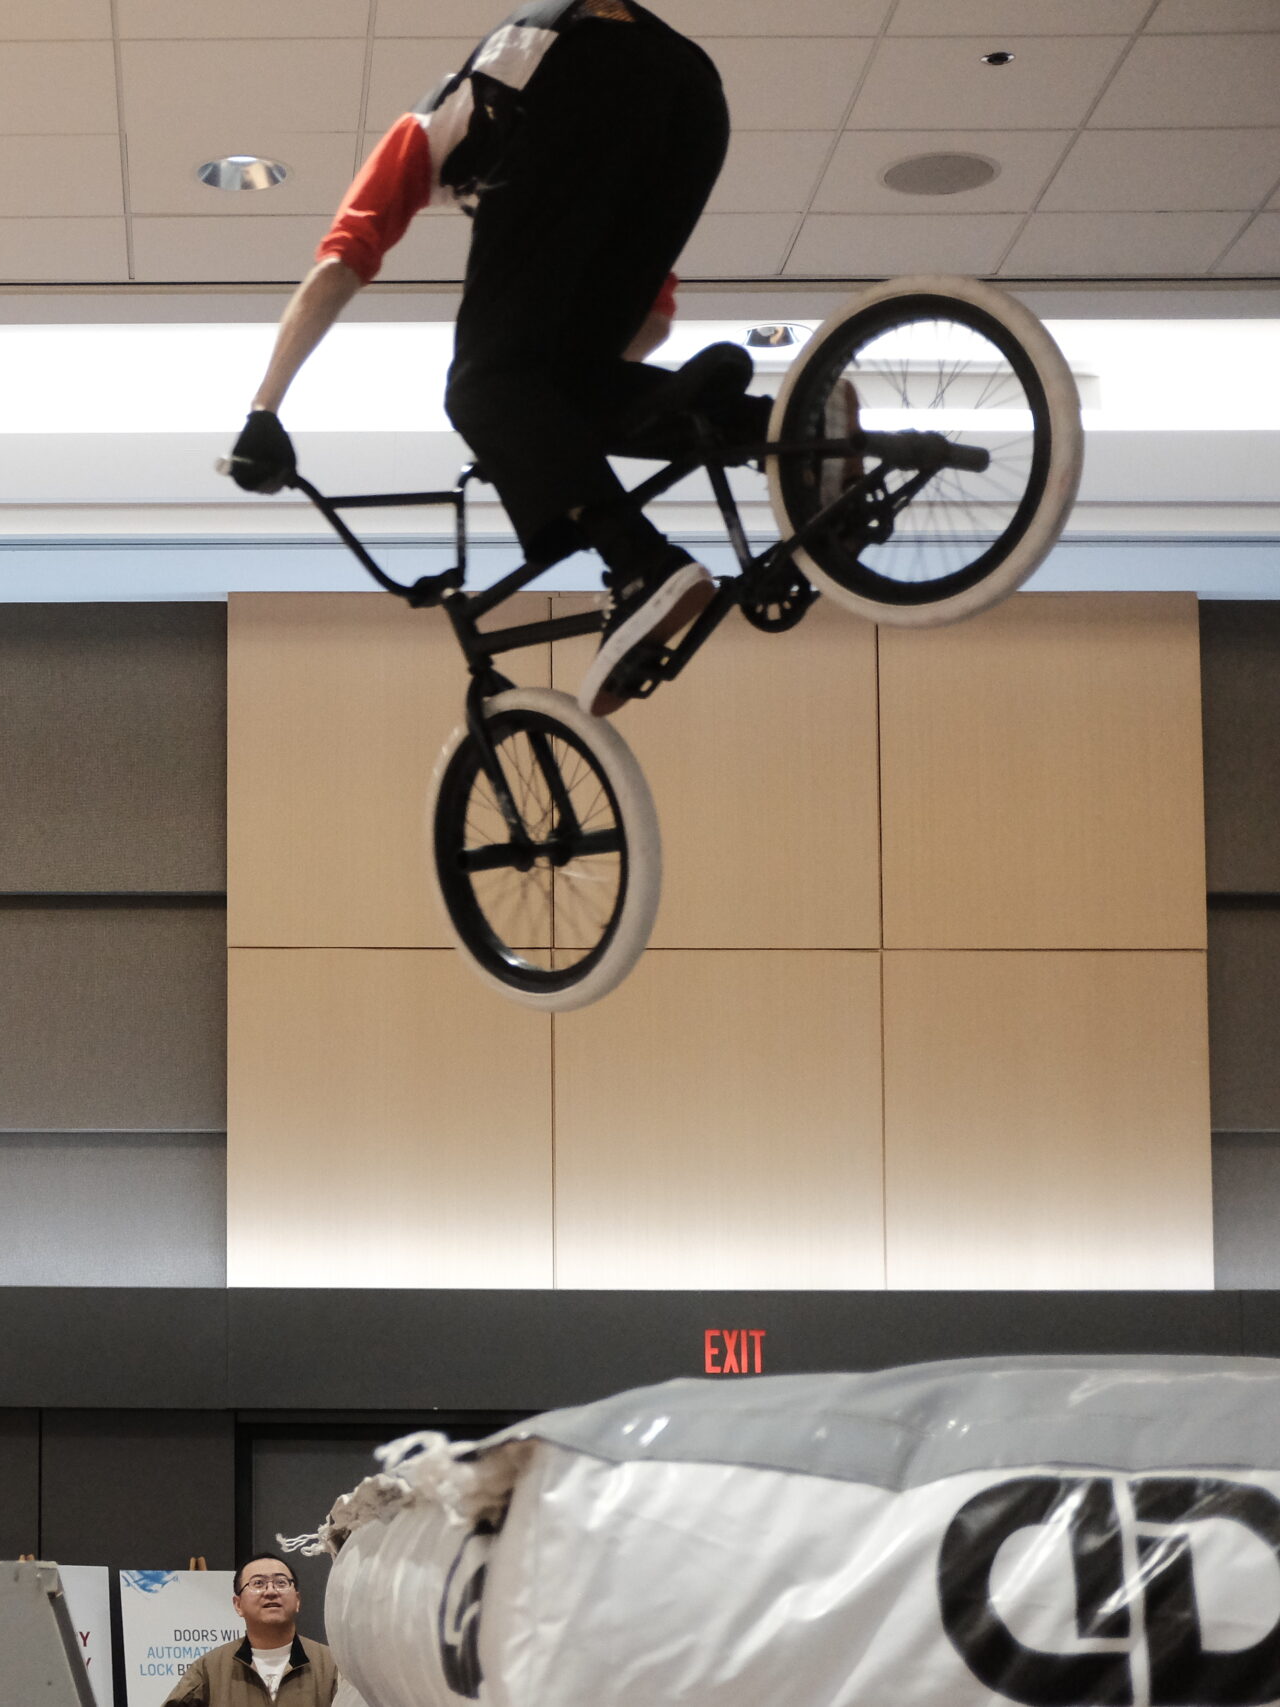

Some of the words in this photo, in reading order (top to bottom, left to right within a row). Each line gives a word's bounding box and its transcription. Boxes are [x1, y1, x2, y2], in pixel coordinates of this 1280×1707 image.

[704, 1329, 766, 1374] EXIT
[174, 1629, 218, 1642] DOORS
[220, 1629, 247, 1641] WIL
[140, 1663, 174, 1676] LOCK
